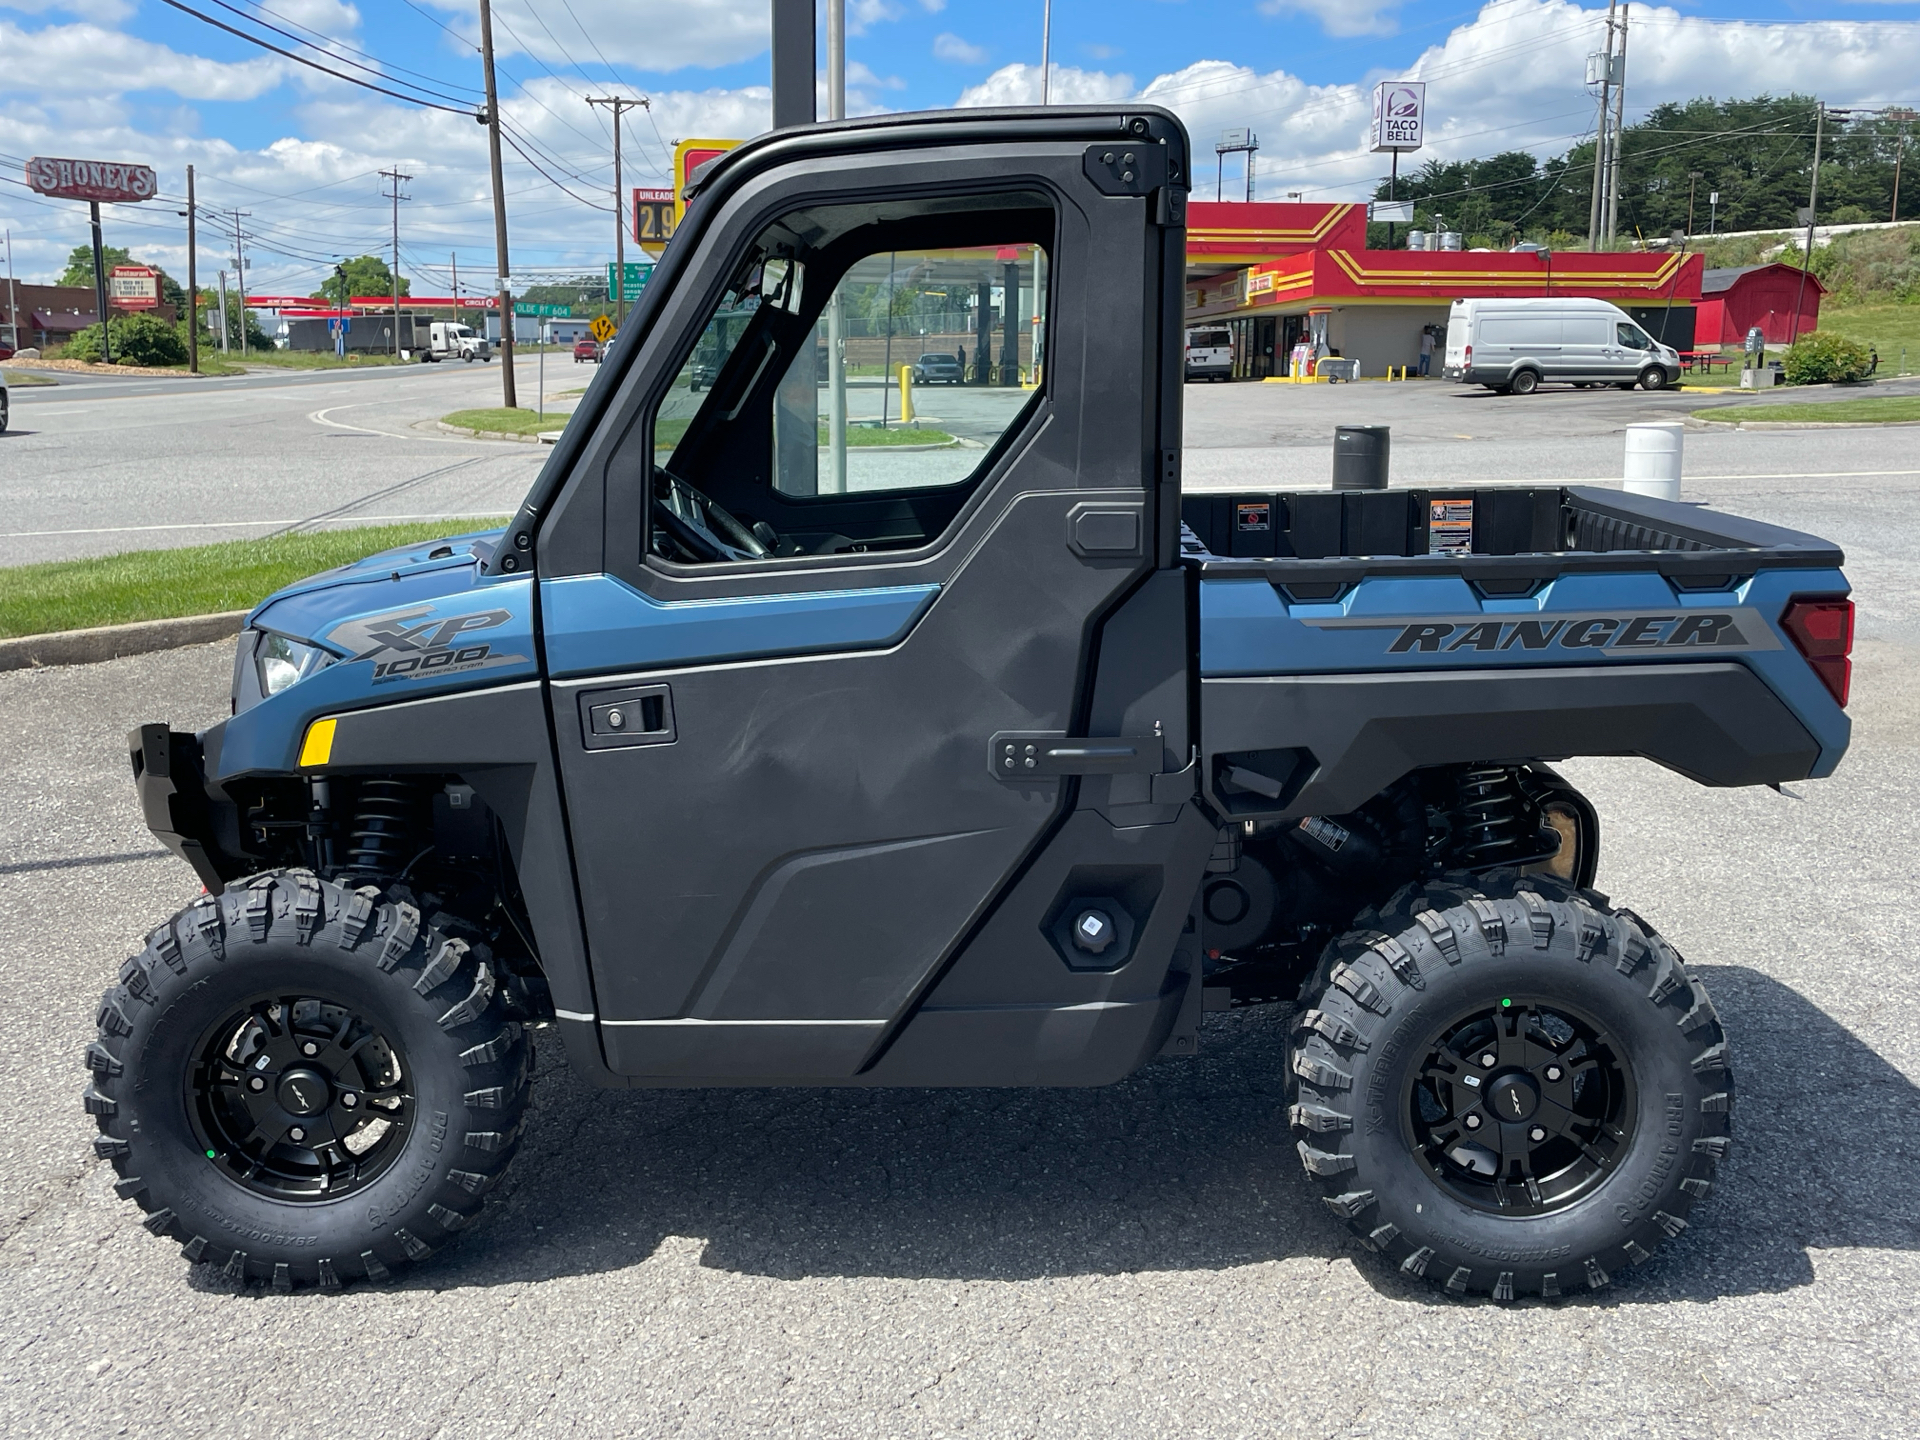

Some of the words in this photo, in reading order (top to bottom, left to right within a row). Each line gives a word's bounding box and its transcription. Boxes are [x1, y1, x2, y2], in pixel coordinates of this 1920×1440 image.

[1386, 120, 1418, 131] TACO
[1387, 131, 1417, 141] BELL
[38, 160, 152, 196] SHONEY'S
[640, 191, 674, 200] UNLEADE
[641, 205, 674, 239] 2.9
[115, 269, 149, 277] Restaurant
[517, 304, 536, 313] OLDE
[540, 305, 549, 314] RT
[552, 307, 568, 316] 604
[350, 607, 515, 662] XP
[1385, 613, 1734, 654] RANGER
[374, 645, 491, 678] 1000
[402, 666, 458, 680] OVERHEAD
[459, 661, 484, 671] CAM
[1365, 1003, 1429, 1137] X-TERRAIN
[1664, 1092, 1685, 1137] PRO
[430, 1110, 449, 1154] PRO
[1629, 1138, 1679, 1211] ARMOR
